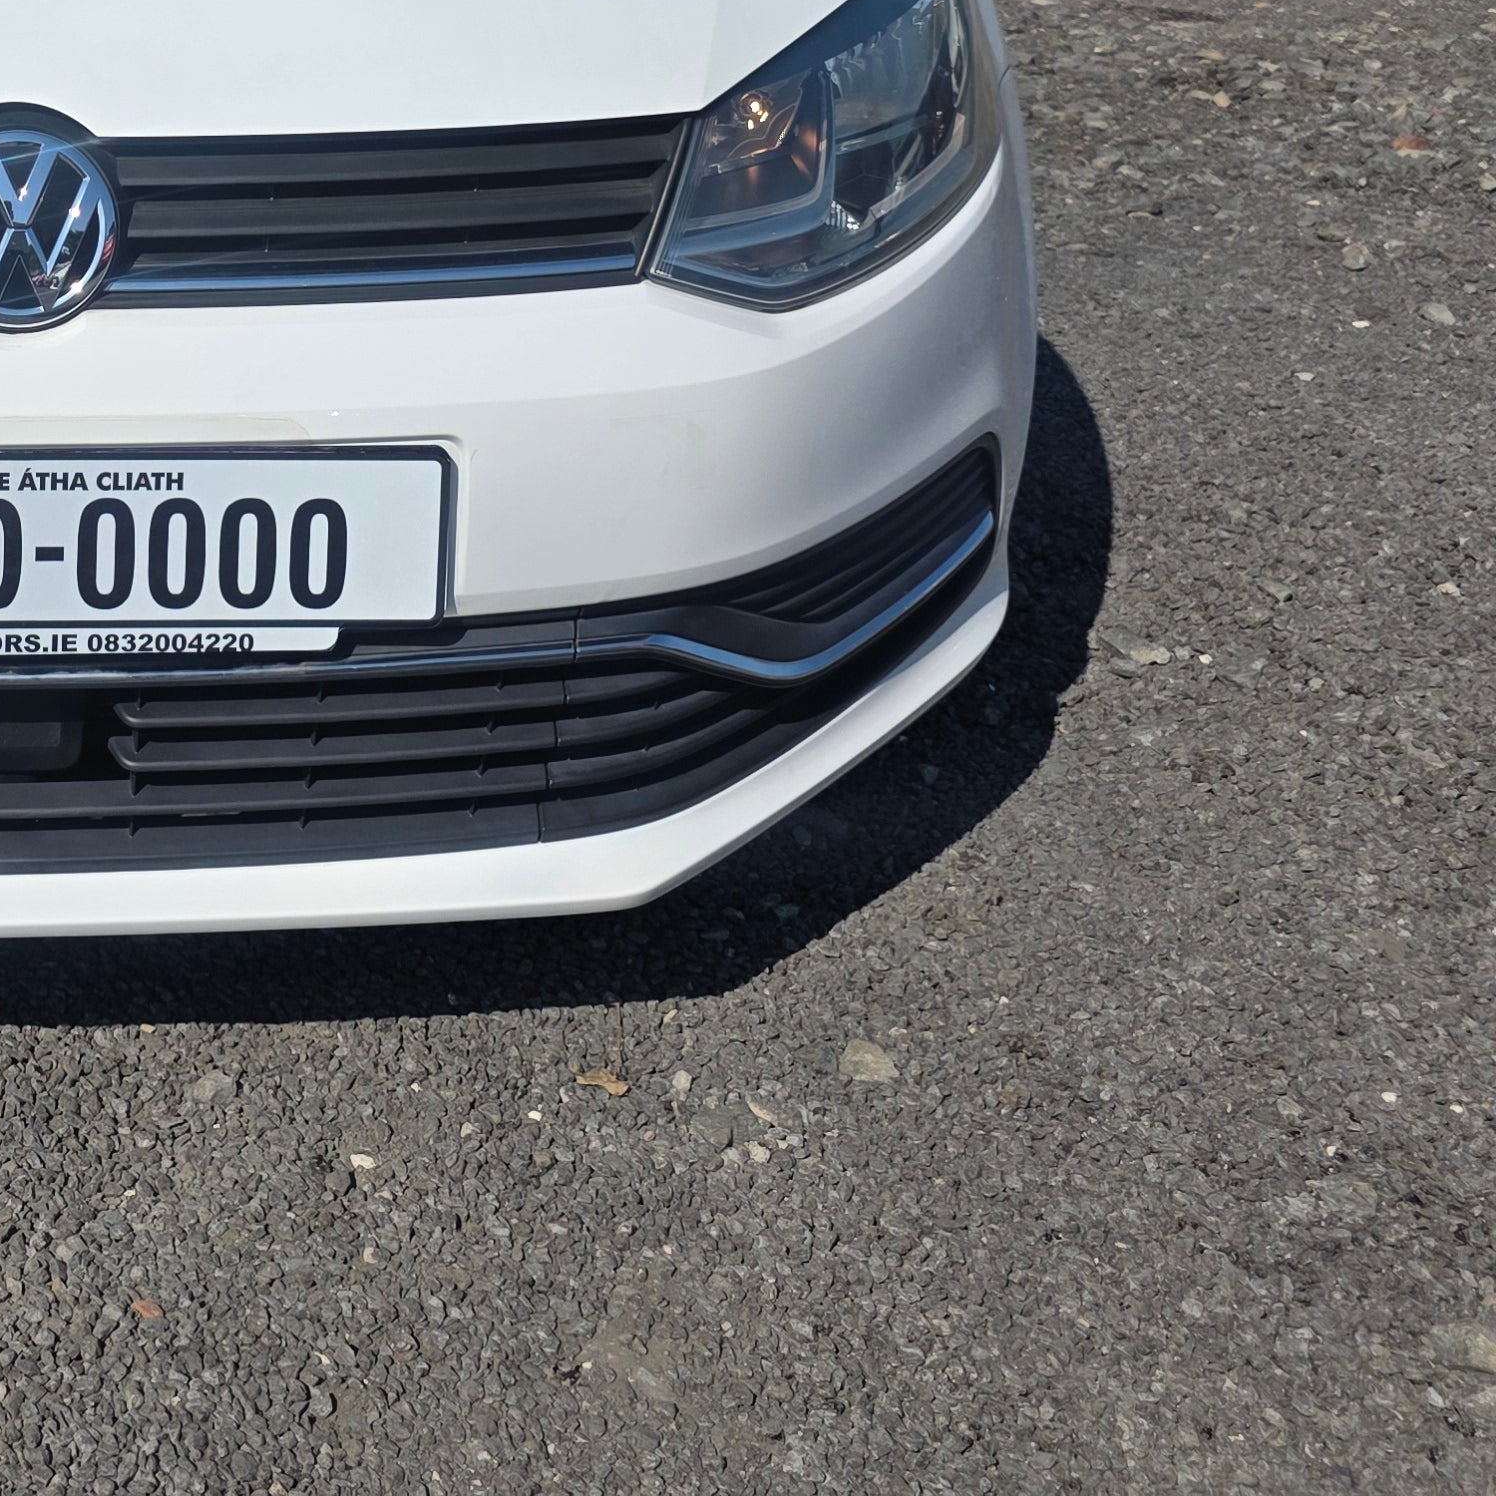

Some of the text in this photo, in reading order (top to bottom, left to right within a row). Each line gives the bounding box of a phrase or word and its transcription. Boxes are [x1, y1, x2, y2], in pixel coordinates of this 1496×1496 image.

[17, 467, 89, 492] ÁTHA
[96, 471, 185, 492] CLIATH
[87, 633, 255, 653] 0832004220
